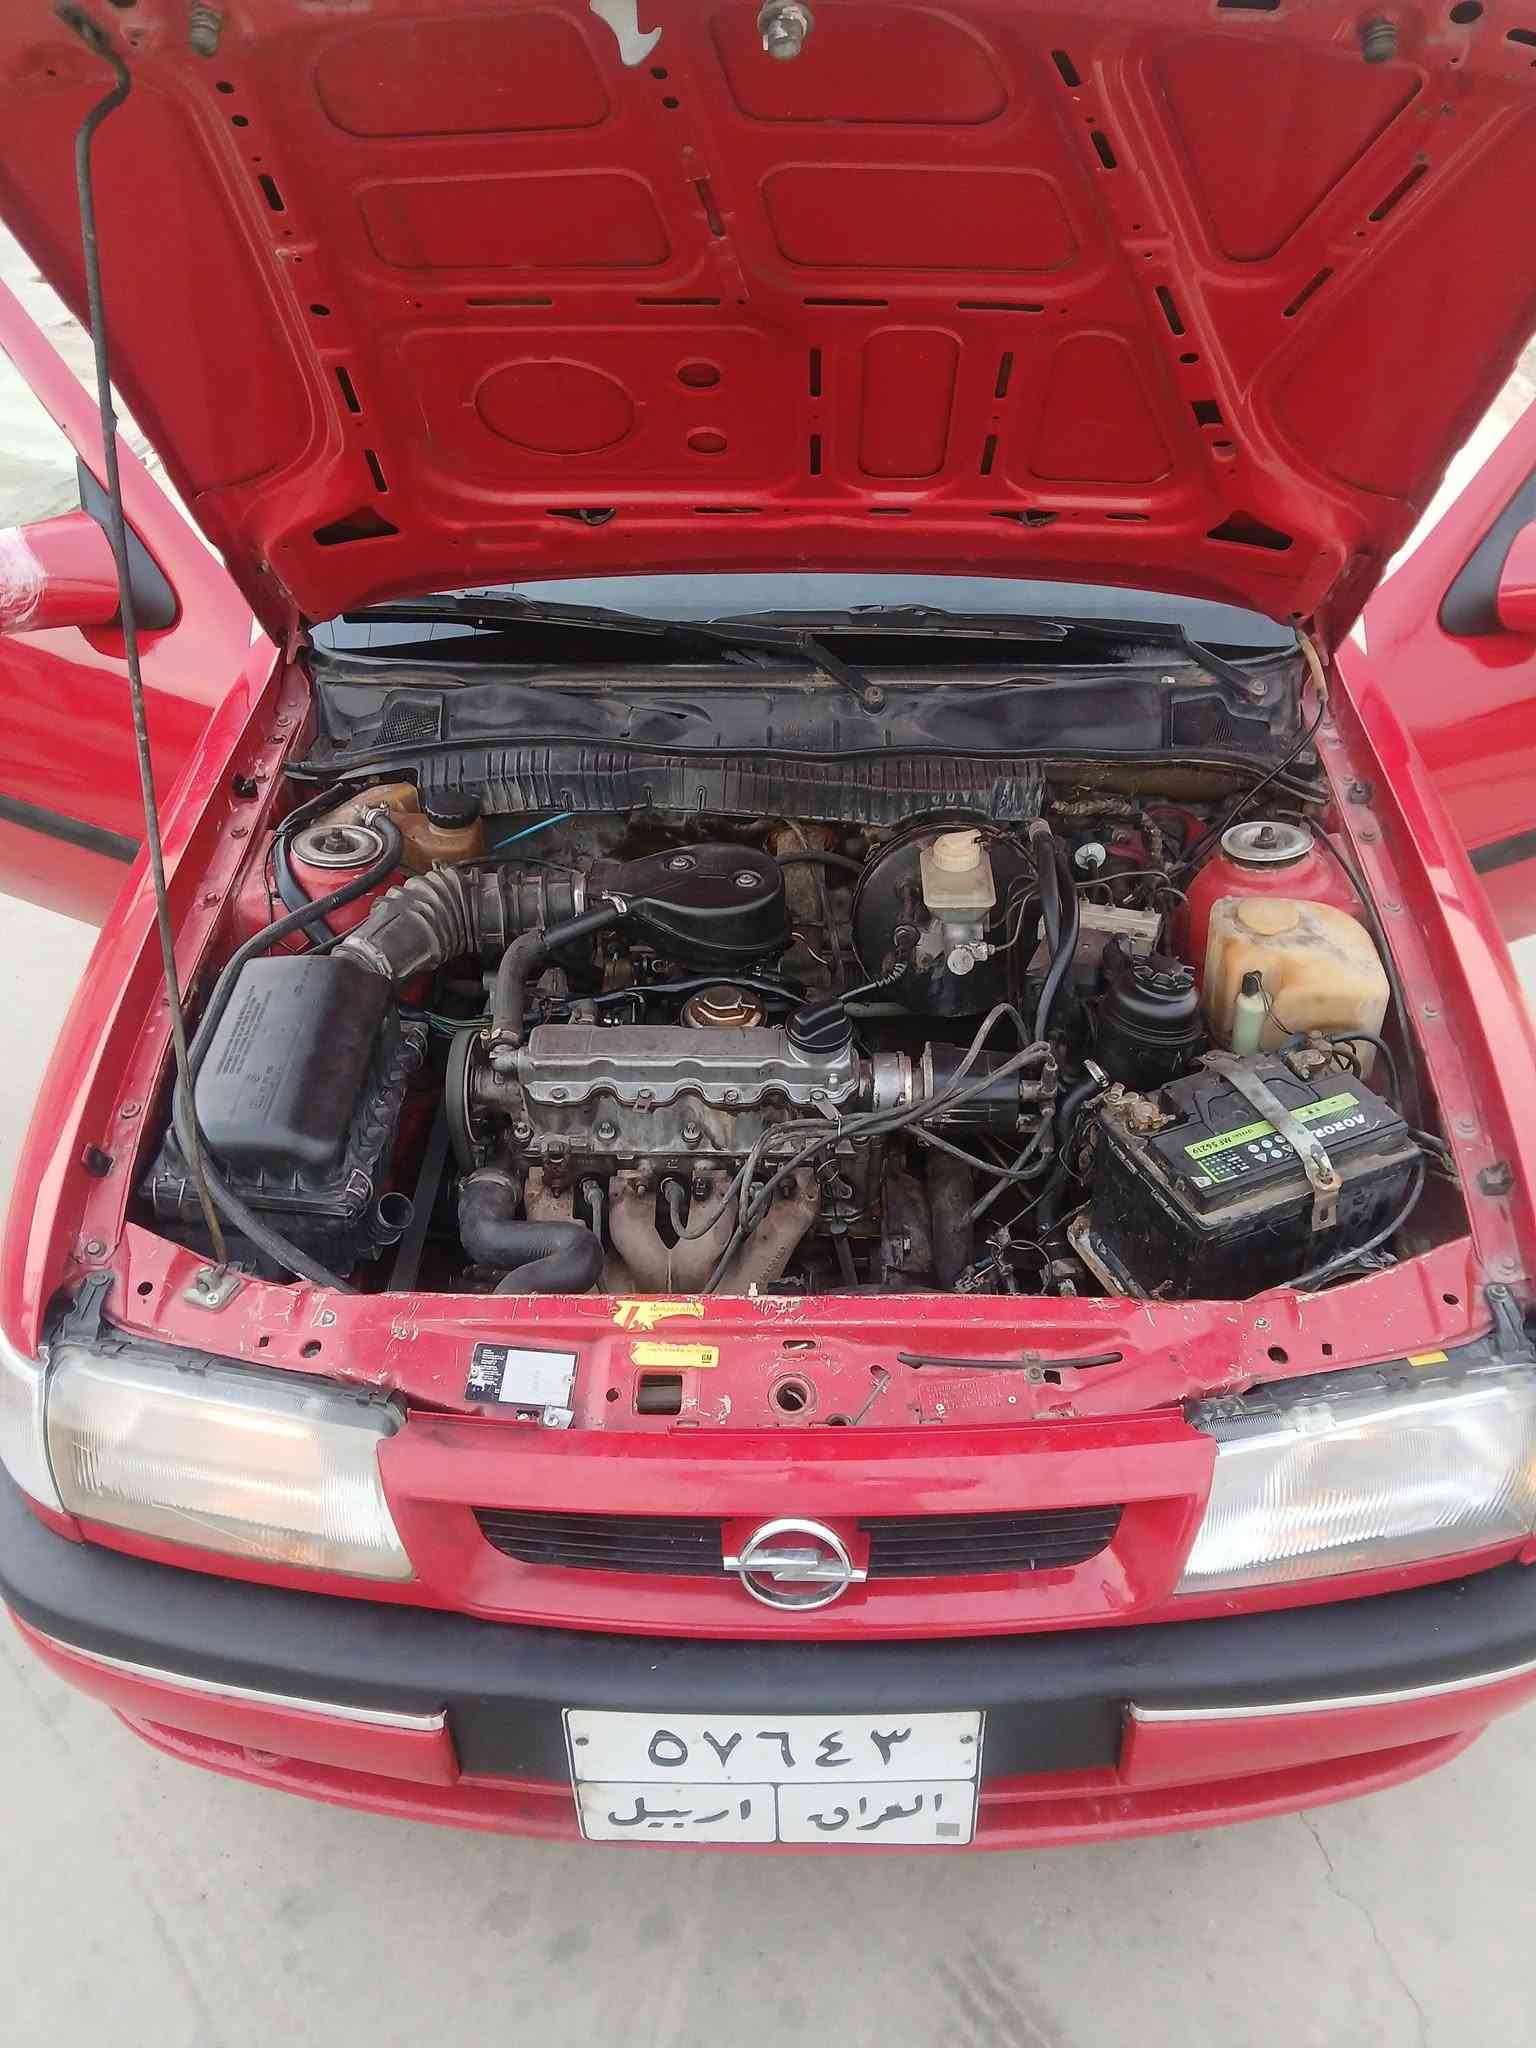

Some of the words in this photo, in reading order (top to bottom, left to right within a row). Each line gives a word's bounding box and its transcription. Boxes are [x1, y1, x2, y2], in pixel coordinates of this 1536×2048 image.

[647, 1728, 912, 1768] ٥٧٦٤٣
[607, 1796, 751, 1829] اربيل
[807, 1793, 943, 1832] العراق
